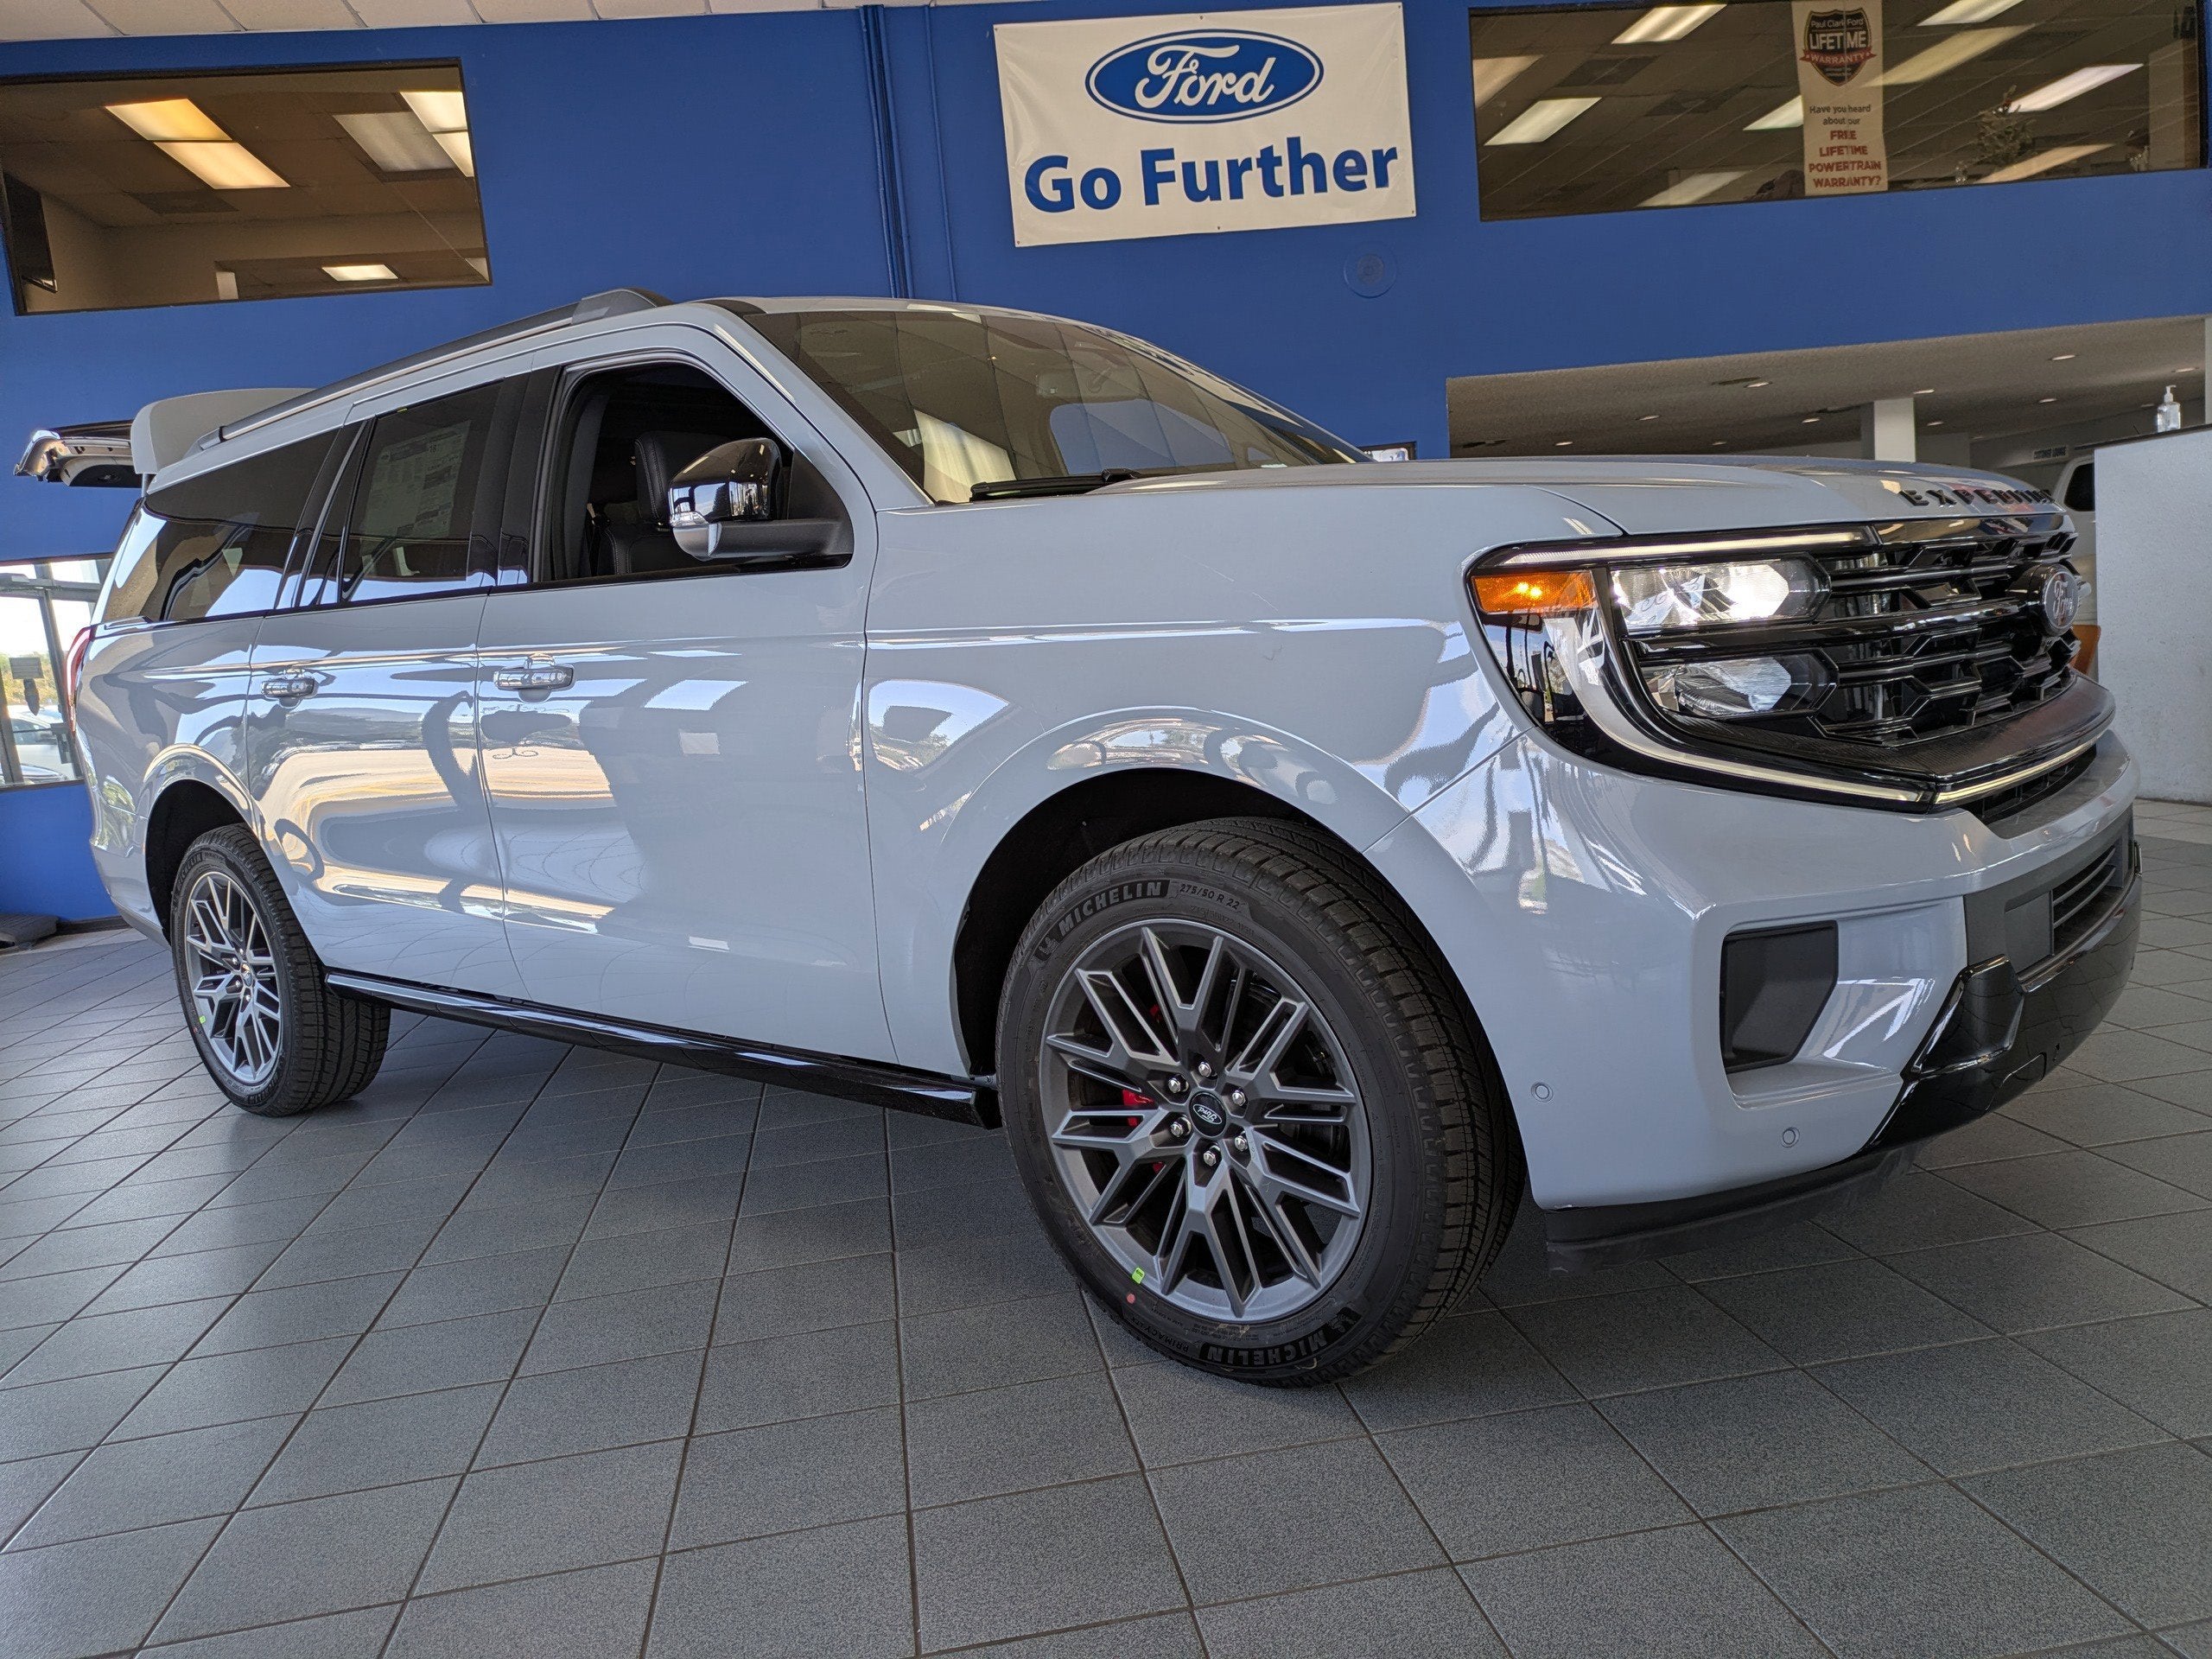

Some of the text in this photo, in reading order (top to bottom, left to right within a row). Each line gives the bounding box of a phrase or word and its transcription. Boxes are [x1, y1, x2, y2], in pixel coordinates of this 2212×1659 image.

[1810, 20, 1827, 29] Paul
[1809, 30, 1866, 50] LIFETME
[1810, 53, 1866, 65] WARRANTY
[1135, 44, 1276, 109] Ford
[1809, 105, 1831, 113] Have
[1848, 104, 1872, 113] heard
[1822, 117, 1847, 125] about
[1830, 130, 1857, 140] FREE
[1819, 145, 1868, 157] LIFETIME
[1808, 160, 1882, 173] POWERTRAIN
[1024, 137, 1398, 213] Go Further
[1813, 175, 1881, 188] WARRANTY?
[1058, 881, 1161, 938] MICHELIN
[1179, 884, 1215, 899] 275/50
[1216, 893, 1225, 903] R
[1226, 899, 1240, 910] 22
[1206, 1332, 1328, 1365] MICHELIN
